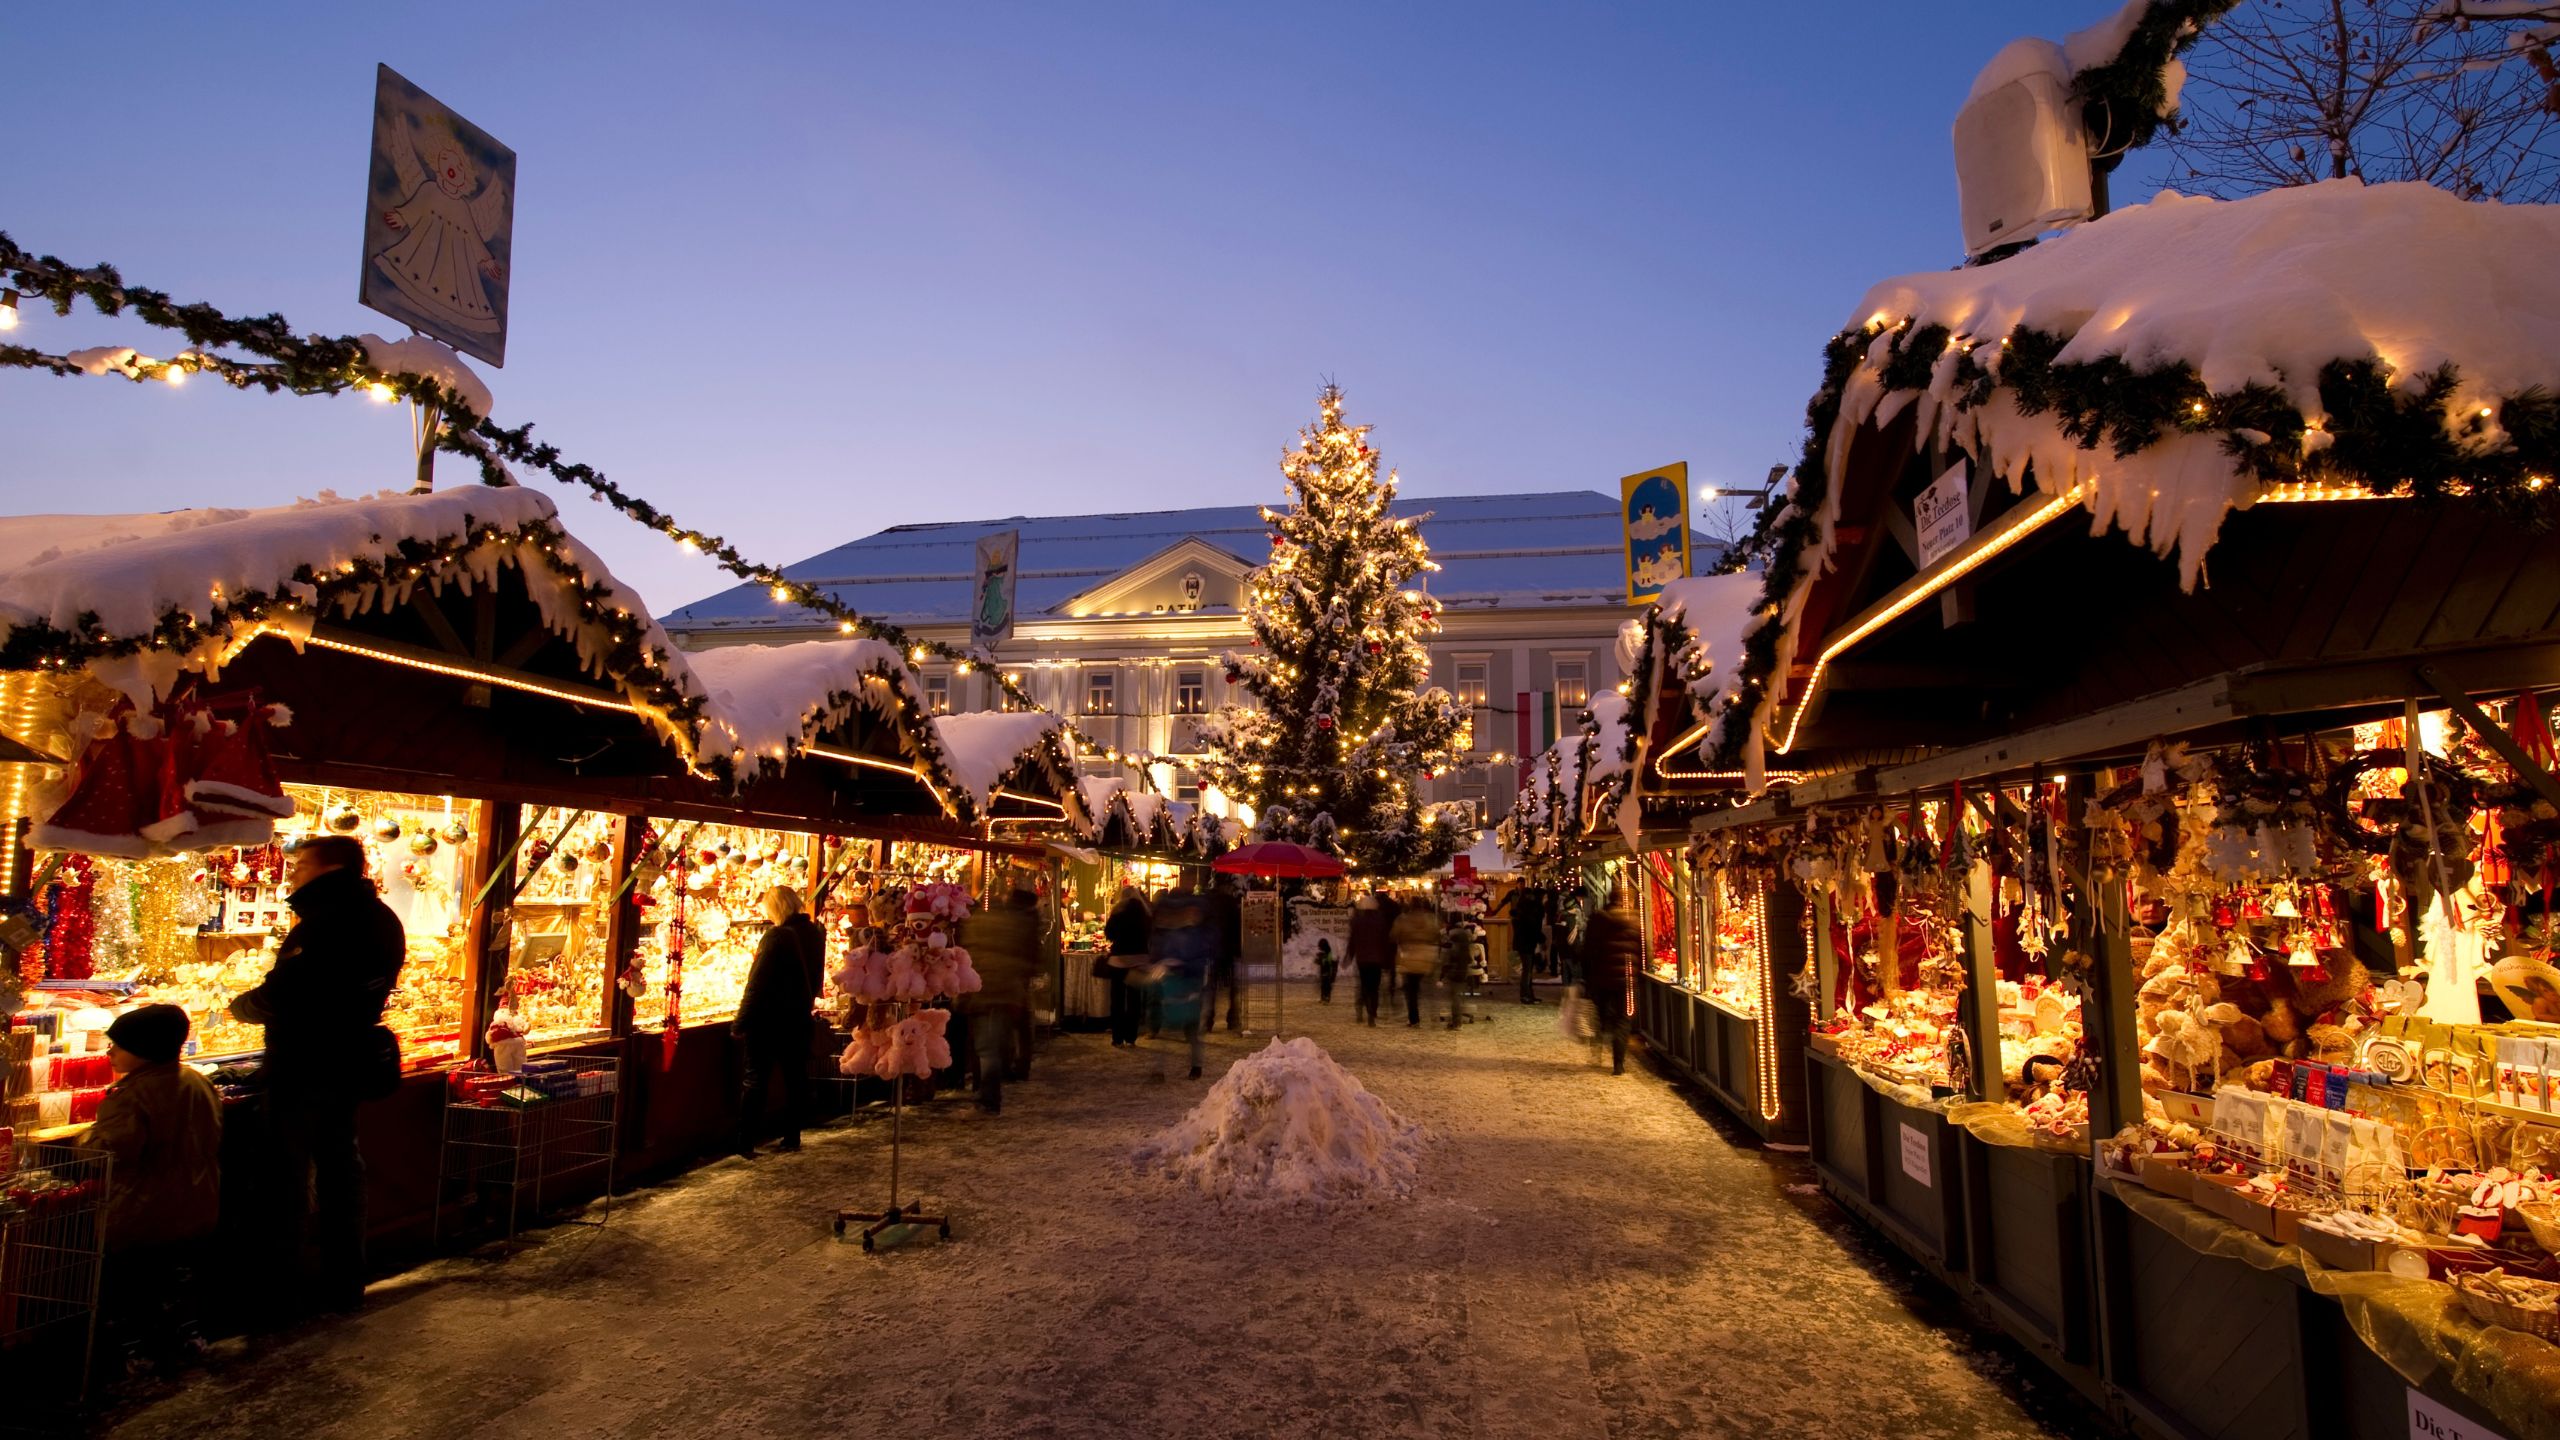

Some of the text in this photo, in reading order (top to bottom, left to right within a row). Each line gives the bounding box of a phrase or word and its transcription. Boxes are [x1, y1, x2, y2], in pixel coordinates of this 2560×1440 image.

[1920, 513, 1931, 529] Die
[1939, 523, 1954, 540] Platz
[2415, 1408, 2444, 1440] Die
